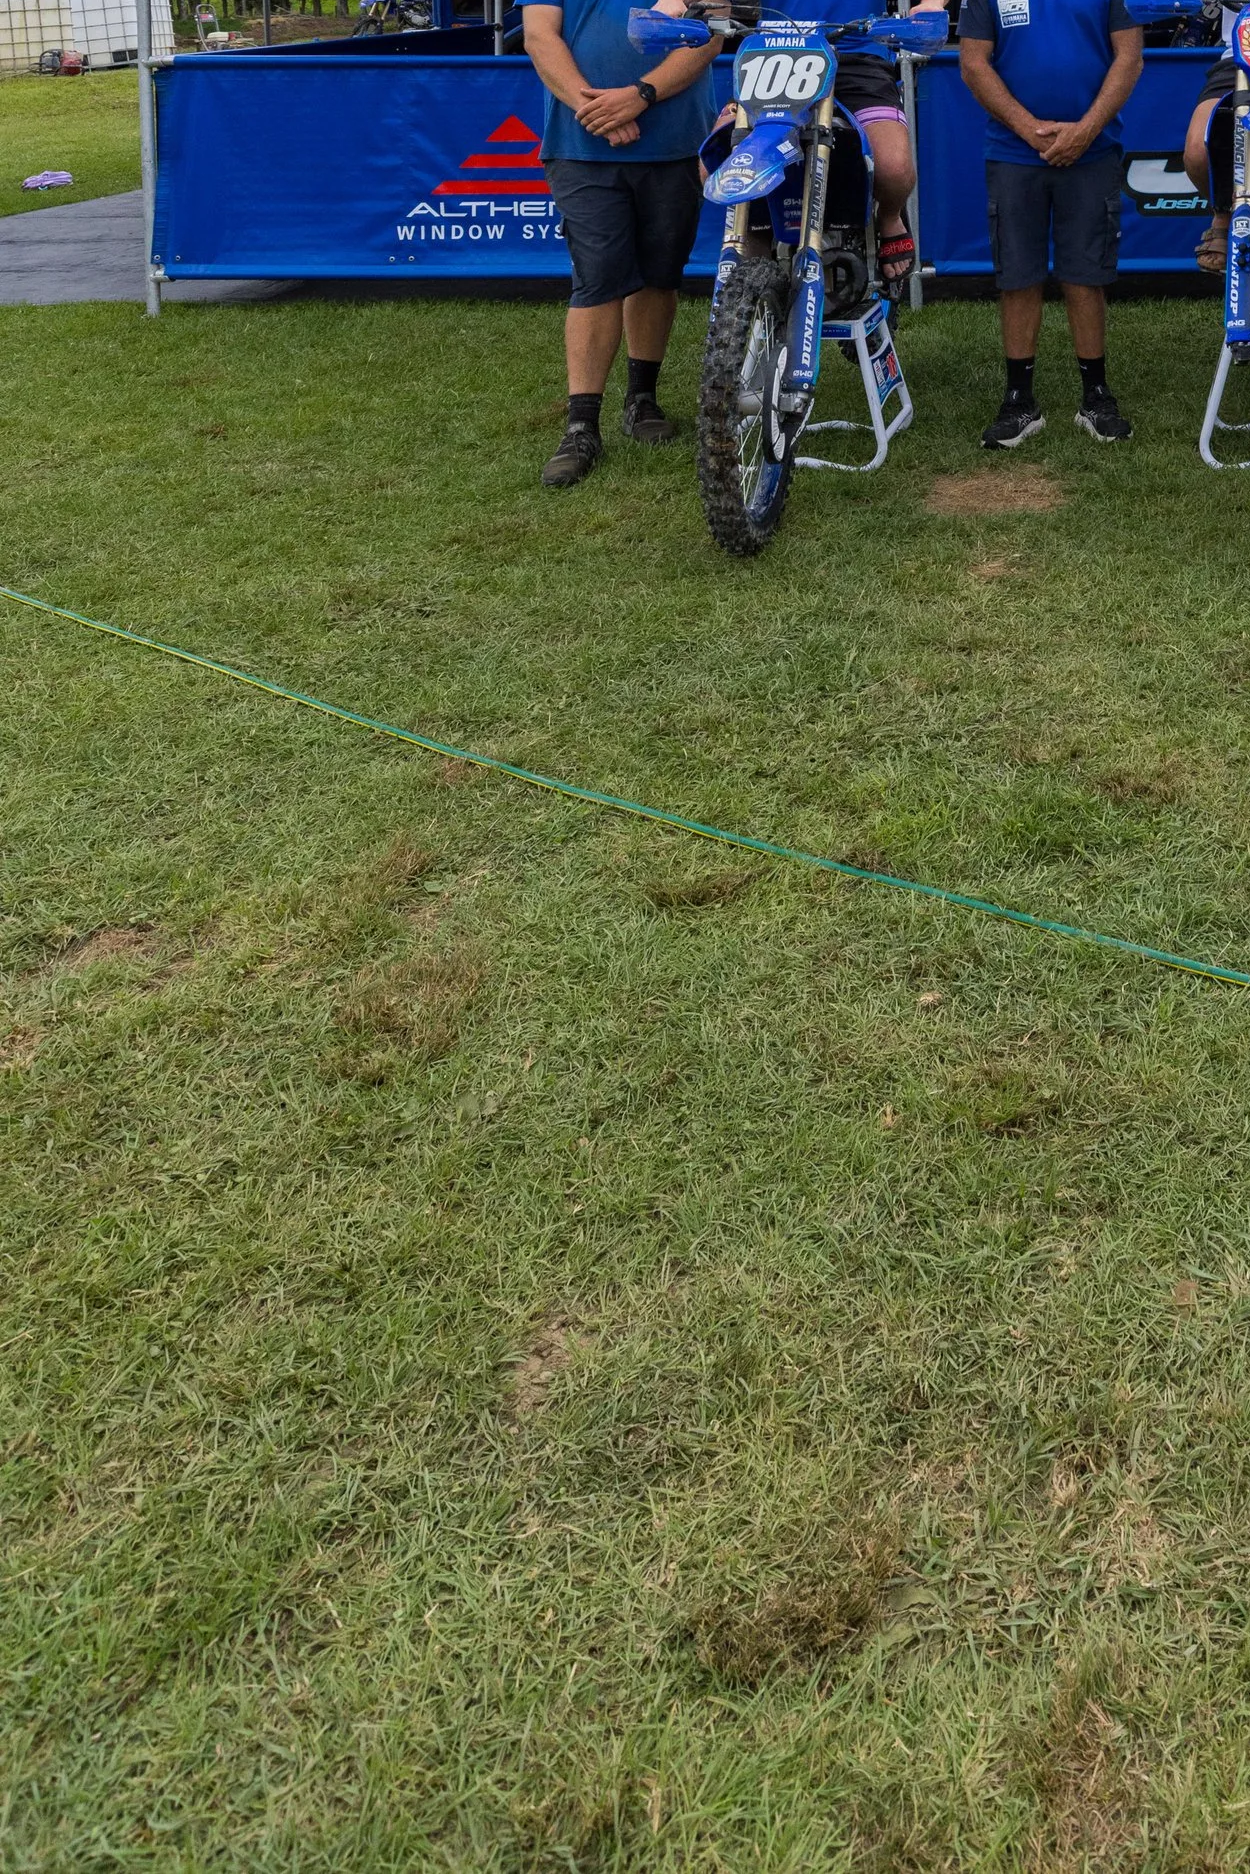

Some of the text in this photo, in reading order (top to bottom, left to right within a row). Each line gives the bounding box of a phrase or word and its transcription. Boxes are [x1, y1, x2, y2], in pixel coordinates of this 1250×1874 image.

[764, 37, 806, 48] YAMAHA
[739, 54, 826, 102] 108
[1143, 197, 1208, 210] Josh
[1235, 220, 1248, 228] KT
[396, 224, 505, 240] WINDOW
[884, 239, 913, 256] ethika
[720, 264, 733, 273] KT
[802, 287, 817, 368] DUNLOP
